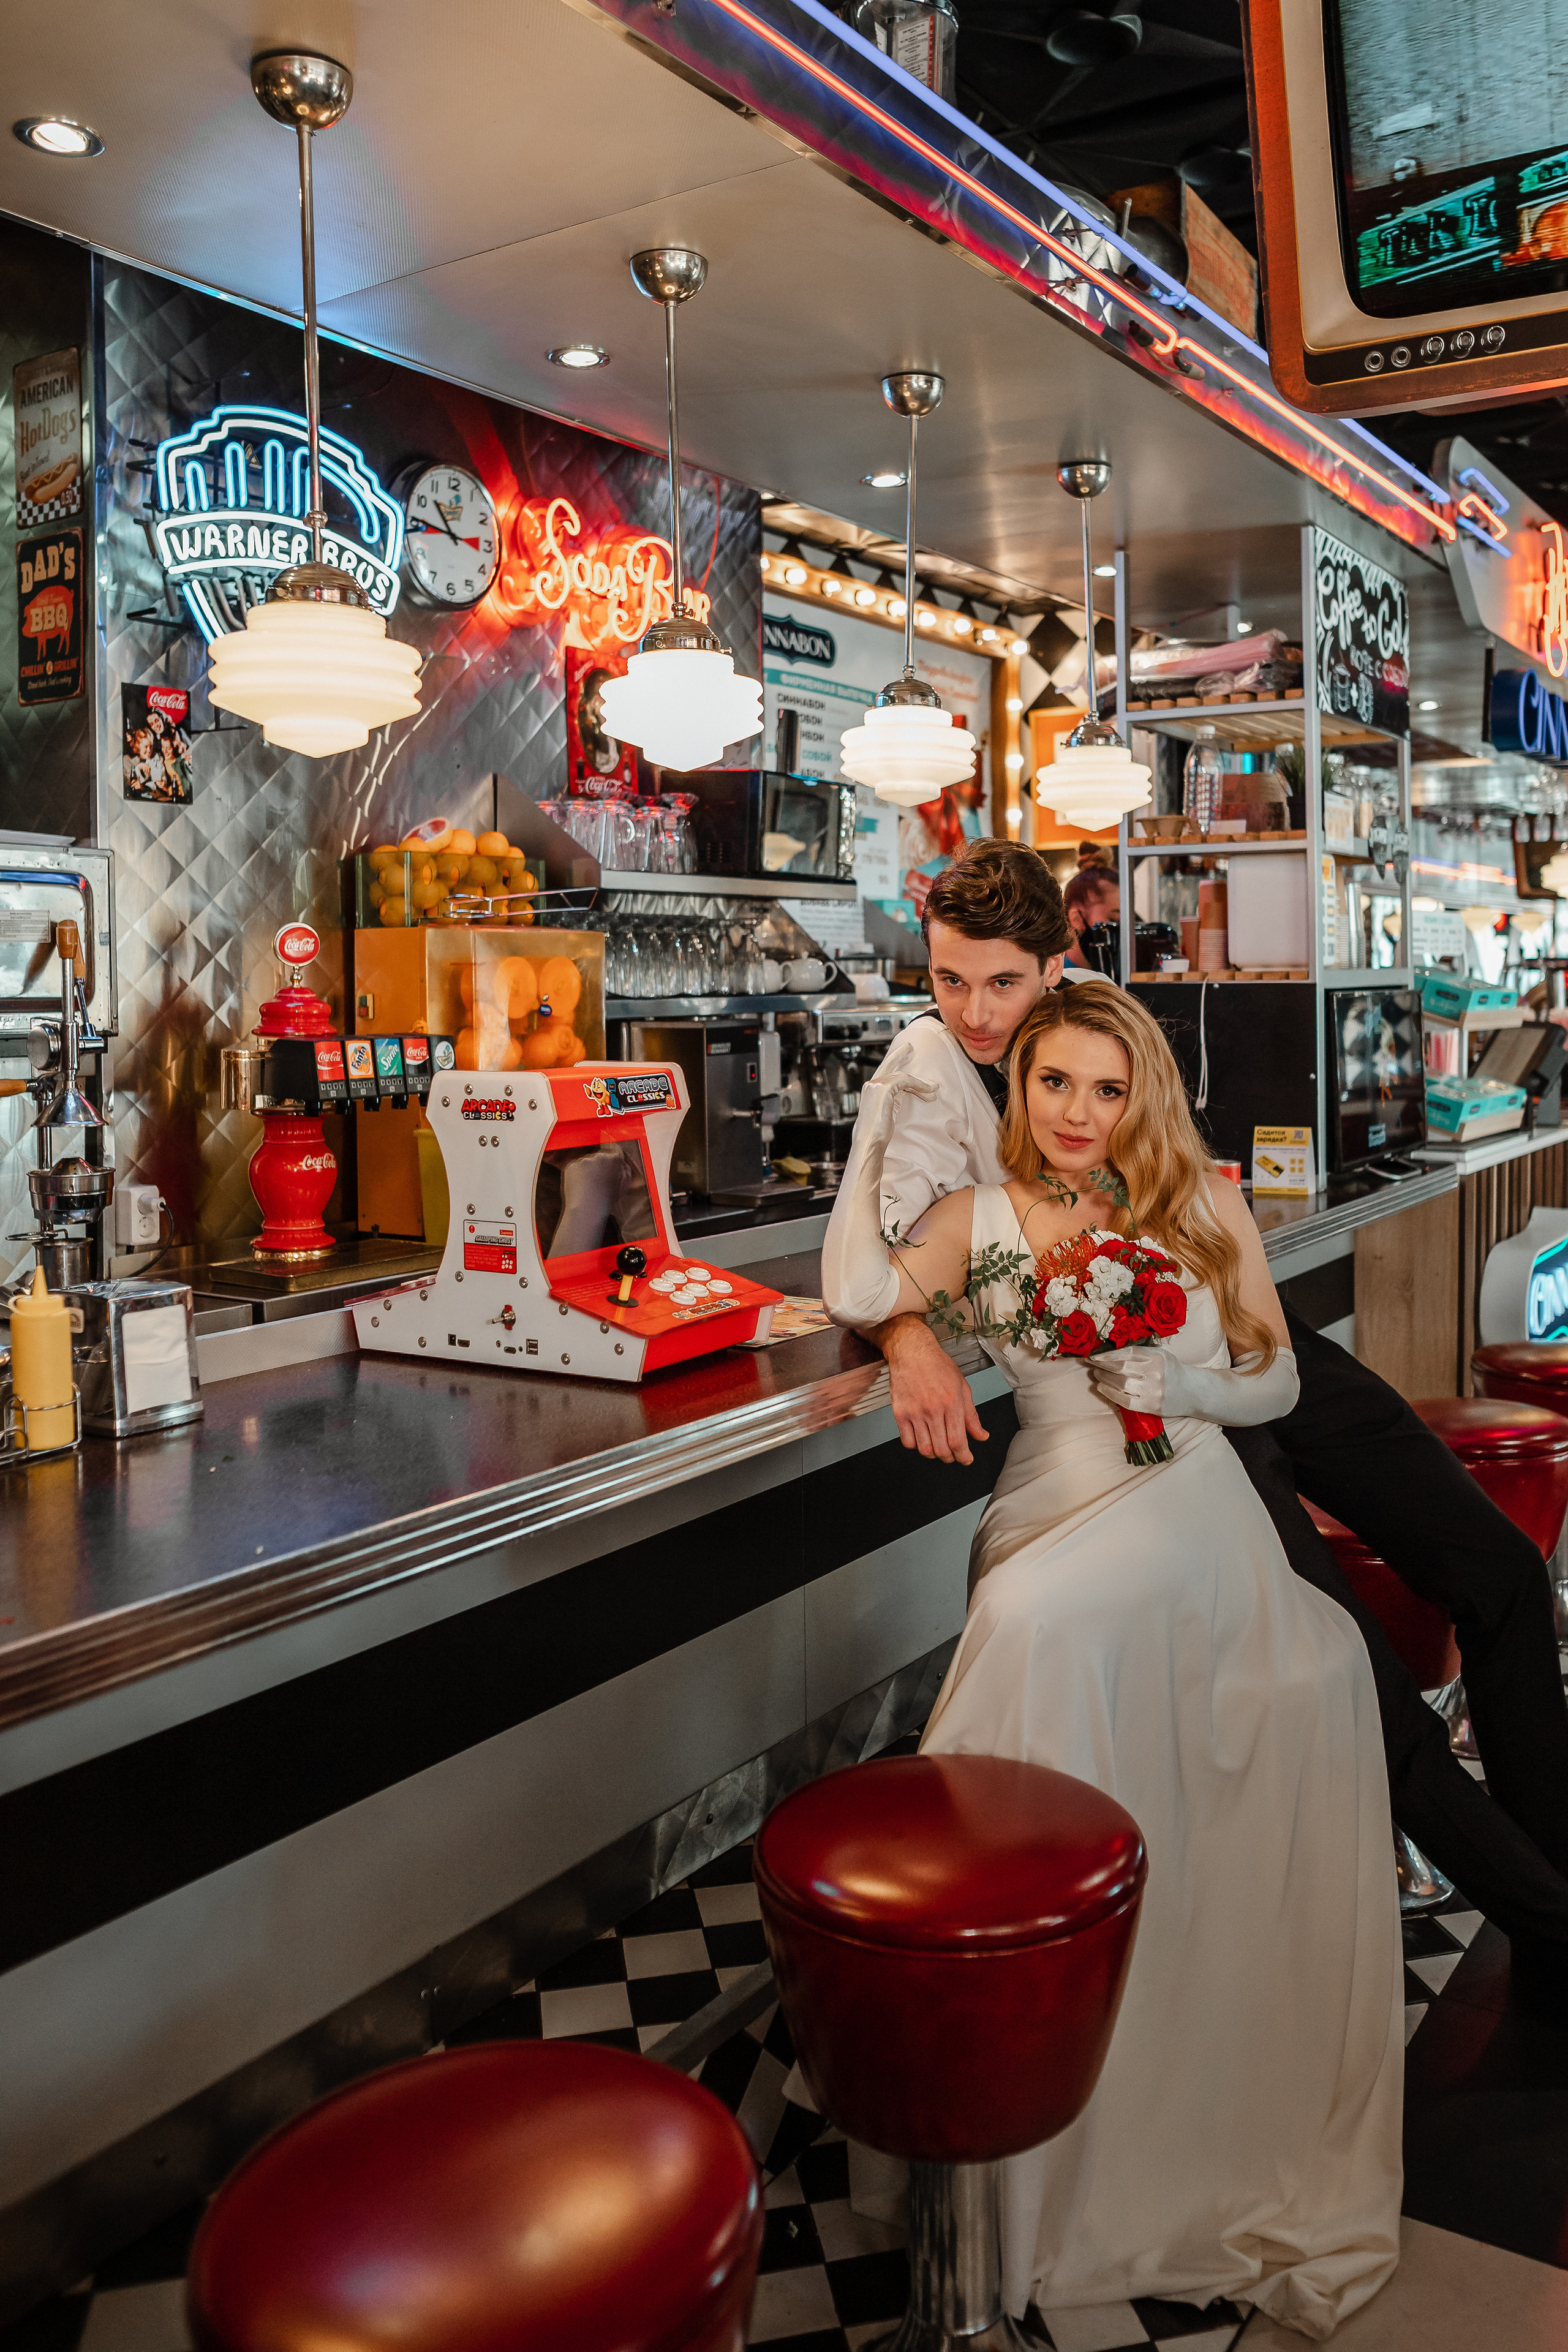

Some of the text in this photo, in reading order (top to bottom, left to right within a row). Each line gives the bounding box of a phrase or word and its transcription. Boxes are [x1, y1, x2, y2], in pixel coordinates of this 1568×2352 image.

[20, 374, 74, 409] AMERICAN
[431, 480, 439, 494] 11
[448, 477, 461, 492] 12
[417, 494, 428, 508] 10
[470, 490, 474, 502] 1
[480, 512, 488, 526] 2
[170, 523, 309, 565] WARNER
[483, 540, 492, 554] 3
[21, 541, 75, 594] DAD'S
[478, 564, 486, 576] 4
[429, 570, 437, 584] 7
[446, 582, 456, 596] 6
[465, 579, 474, 592] 5
[1317, 565, 1365, 650] Coffee
[30, 603, 69, 633] BBQ
[763, 623, 832, 661] NNABON
[149, 690, 187, 710] Coca-Cola
[284, 937, 316, 954] Coca-Cola
[317, 1050, 342, 1063] Coca-Cola
[351, 1045, 367, 1071] Fanta
[380, 1044, 399, 1071] Sprite
[406, 1047, 428, 1057] Coca-Cola
[618, 1077, 668, 1095] ARCADE
[461, 1098, 510, 1114] ARCADE
[302, 1153, 336, 1171] Coca-Cola
[475, 1235, 514, 1245] GALLOPING GHOST
